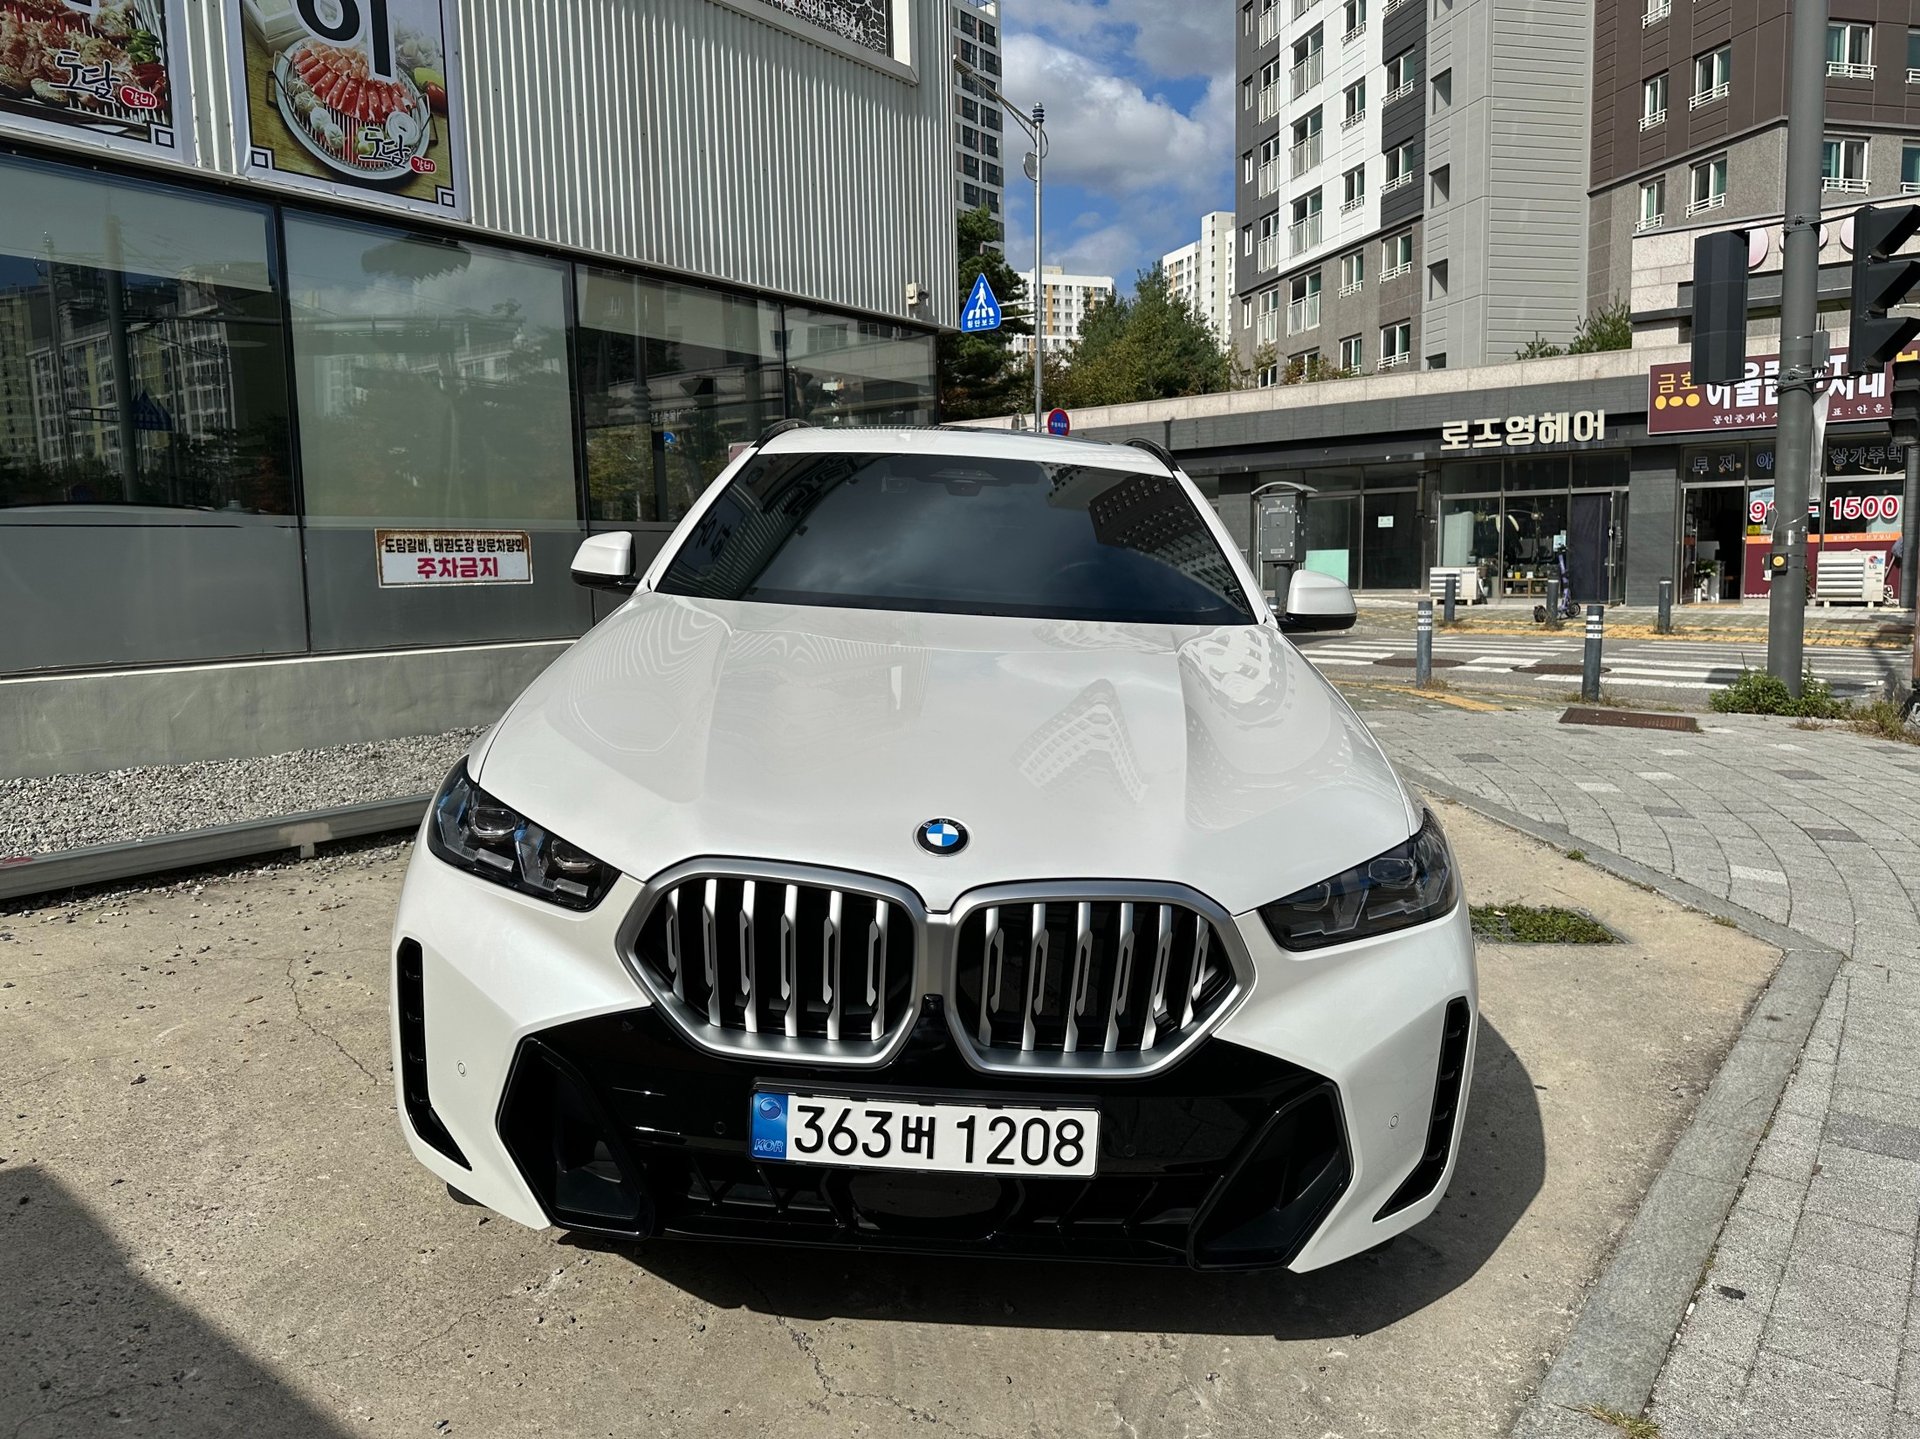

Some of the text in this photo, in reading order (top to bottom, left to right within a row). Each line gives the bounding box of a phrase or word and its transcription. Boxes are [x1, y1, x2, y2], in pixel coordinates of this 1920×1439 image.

[129, 89, 153, 105] 갈비
[416, 157, 434, 171] 갈비
[1658, 371, 1698, 394] 금호
[1712, 412, 1767, 425] 공인중개사
[1440, 409, 1605, 451] 로즈영헤어
[1831, 445, 1904, 465] 상가주택
[433, 537, 474, 553] 태권도장
[476, 538, 525, 553] 방문차량외
[417, 556, 499, 579] 주차금지
[794, 1104, 1085, 1168] 363버 1208
[754, 1138, 784, 1153] KOR
